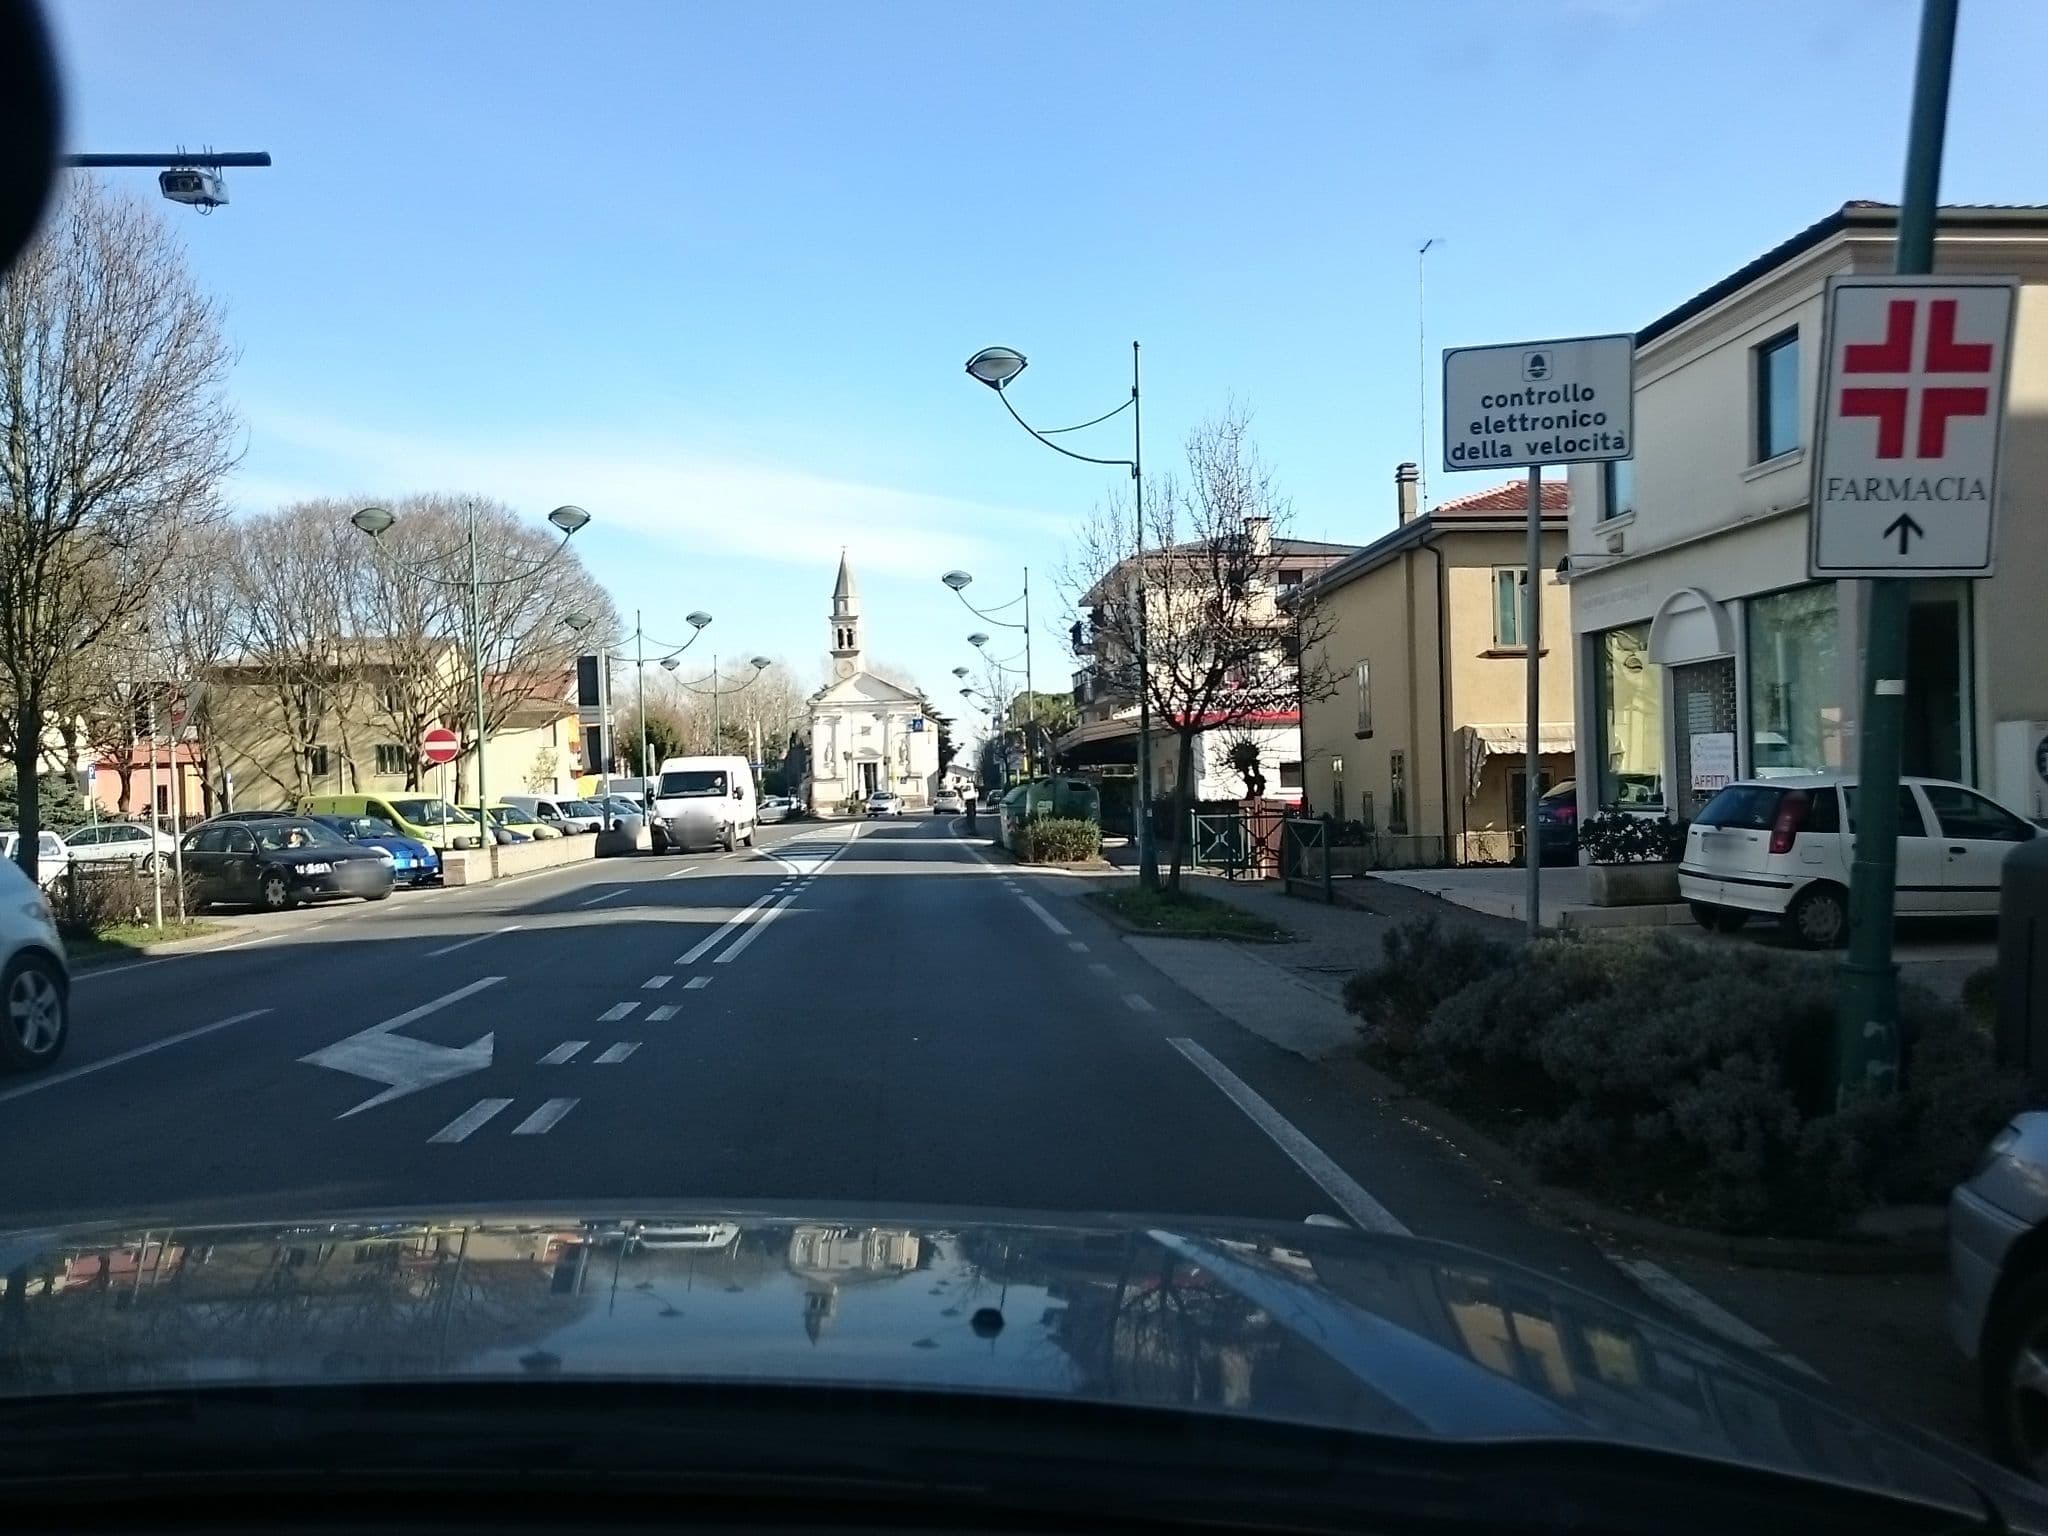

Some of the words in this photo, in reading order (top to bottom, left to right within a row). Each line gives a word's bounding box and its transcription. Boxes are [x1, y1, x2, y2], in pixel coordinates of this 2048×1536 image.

[1481, 383, 1595, 409] controllo
[1469, 409, 1607, 435] elettronico
[1451, 439, 1513, 461] della
[1526, 430, 1626, 456] velocità
[1825, 477, 1987, 501] FARMACIA
